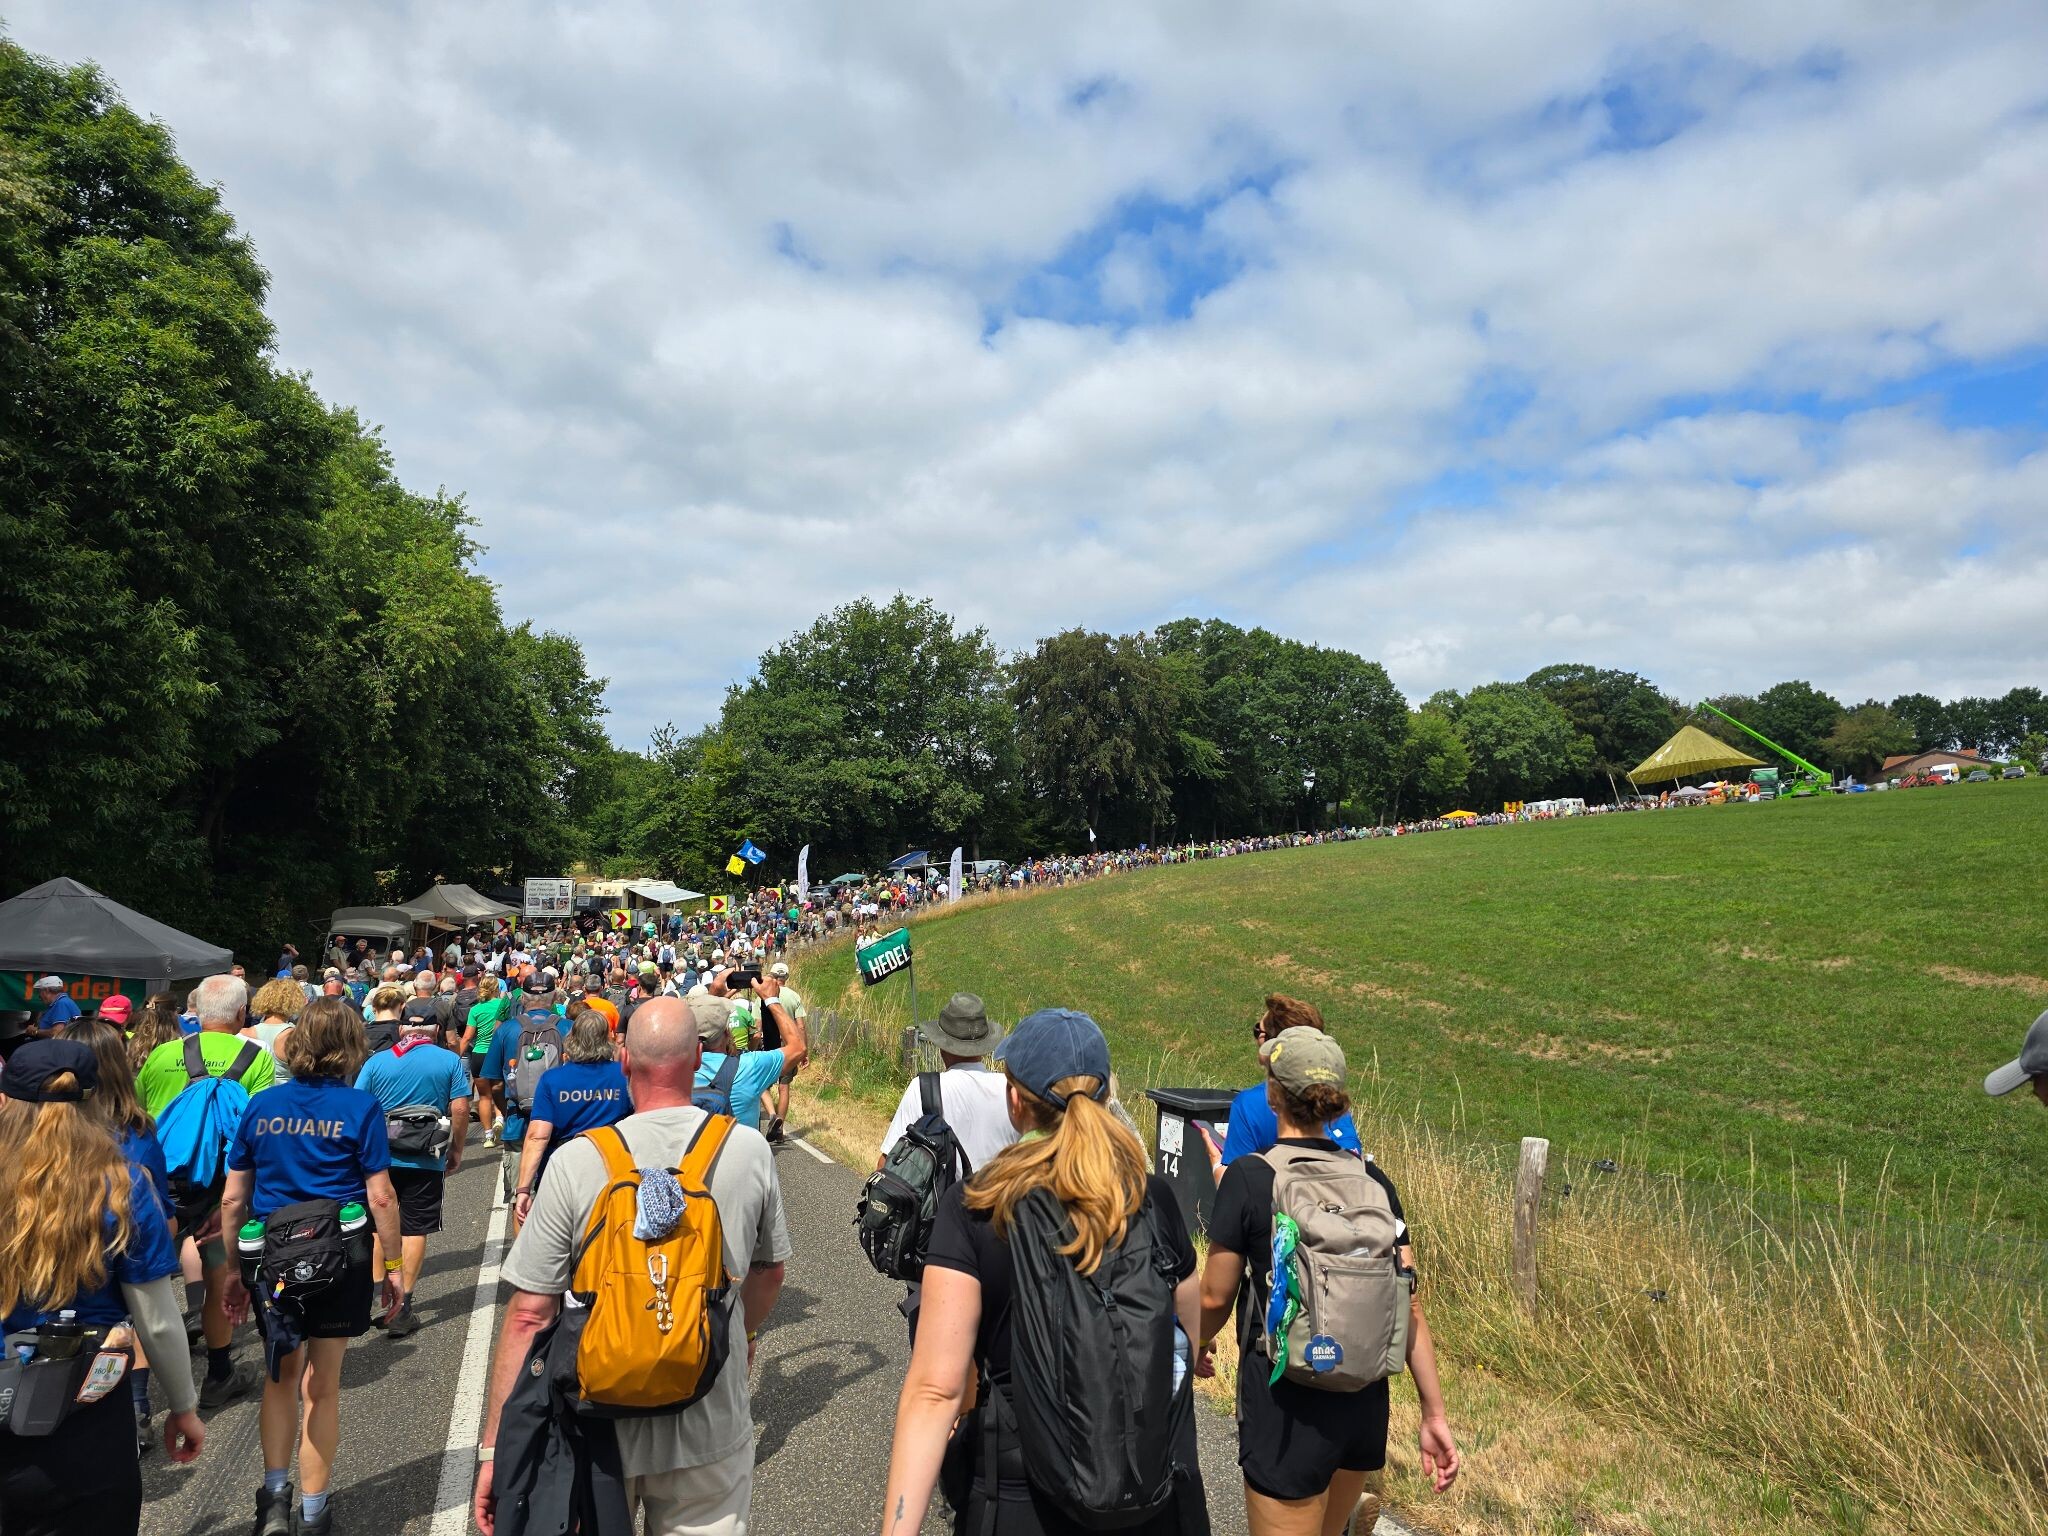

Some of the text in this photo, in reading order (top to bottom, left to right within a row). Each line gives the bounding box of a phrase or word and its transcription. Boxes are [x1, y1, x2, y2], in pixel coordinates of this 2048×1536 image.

[868, 943, 910, 979] HEDEL
[559, 1088, 620, 1103] DOUANE
[256, 1116, 345, 1138] DOUANE
[1161, 1152, 1179, 1178] 14
